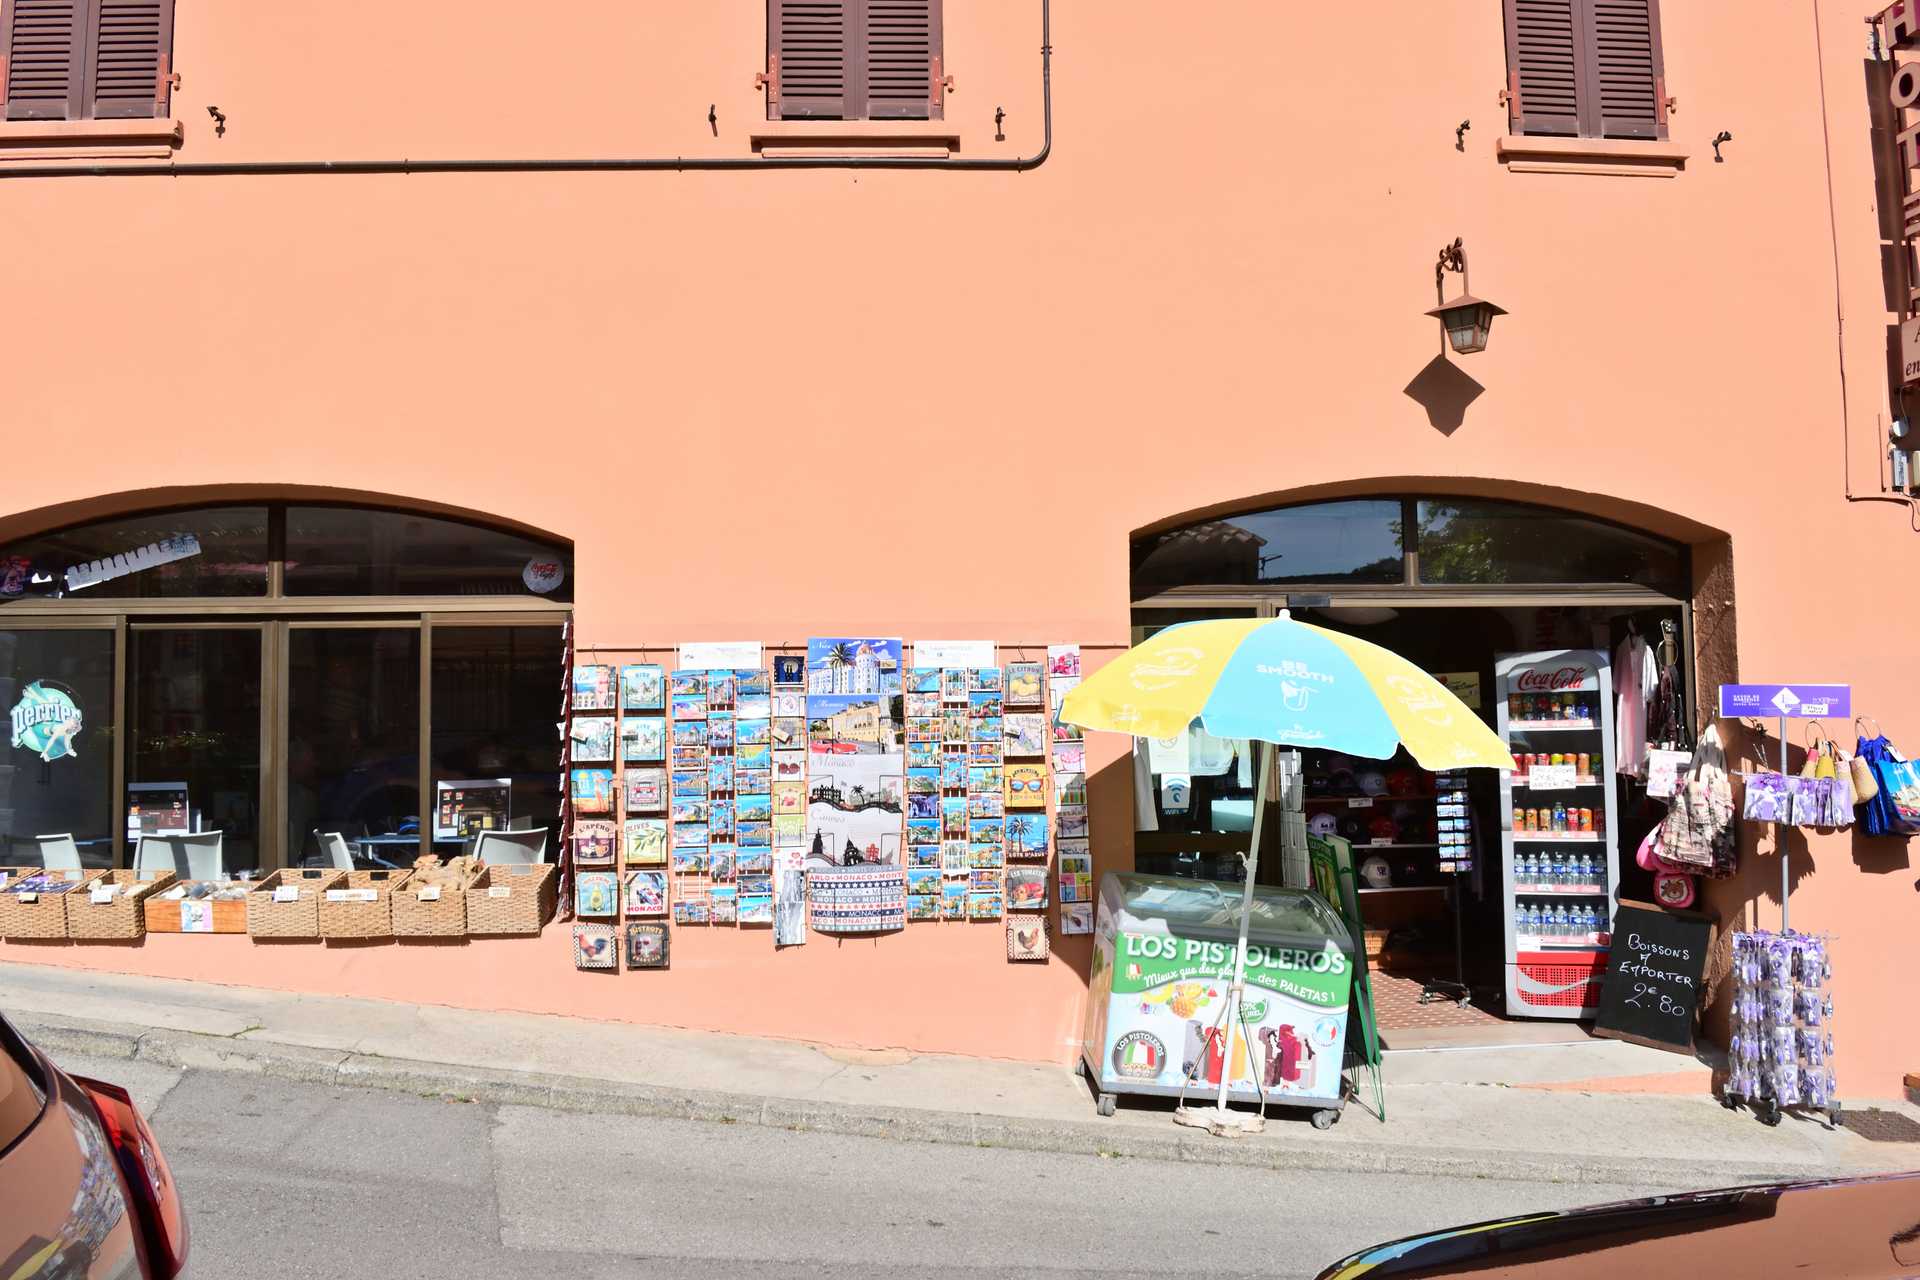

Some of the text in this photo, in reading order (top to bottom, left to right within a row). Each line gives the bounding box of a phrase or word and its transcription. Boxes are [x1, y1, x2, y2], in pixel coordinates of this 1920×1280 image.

[1256, 664, 1334, 684] SMOOTH
[1124, 934, 1346, 975] LOS PISTOLEROS
[1143, 970, 1179, 988] Mieux
[1179, 966, 1198, 980] que
[1217, 962, 1248, 980] glas
[1279, 978, 1329, 1002] PALETAS
[1619, 961, 1693, 988] EMPORTER
[1117, 1032, 1165, 1057] LOS PISTOLEROS
